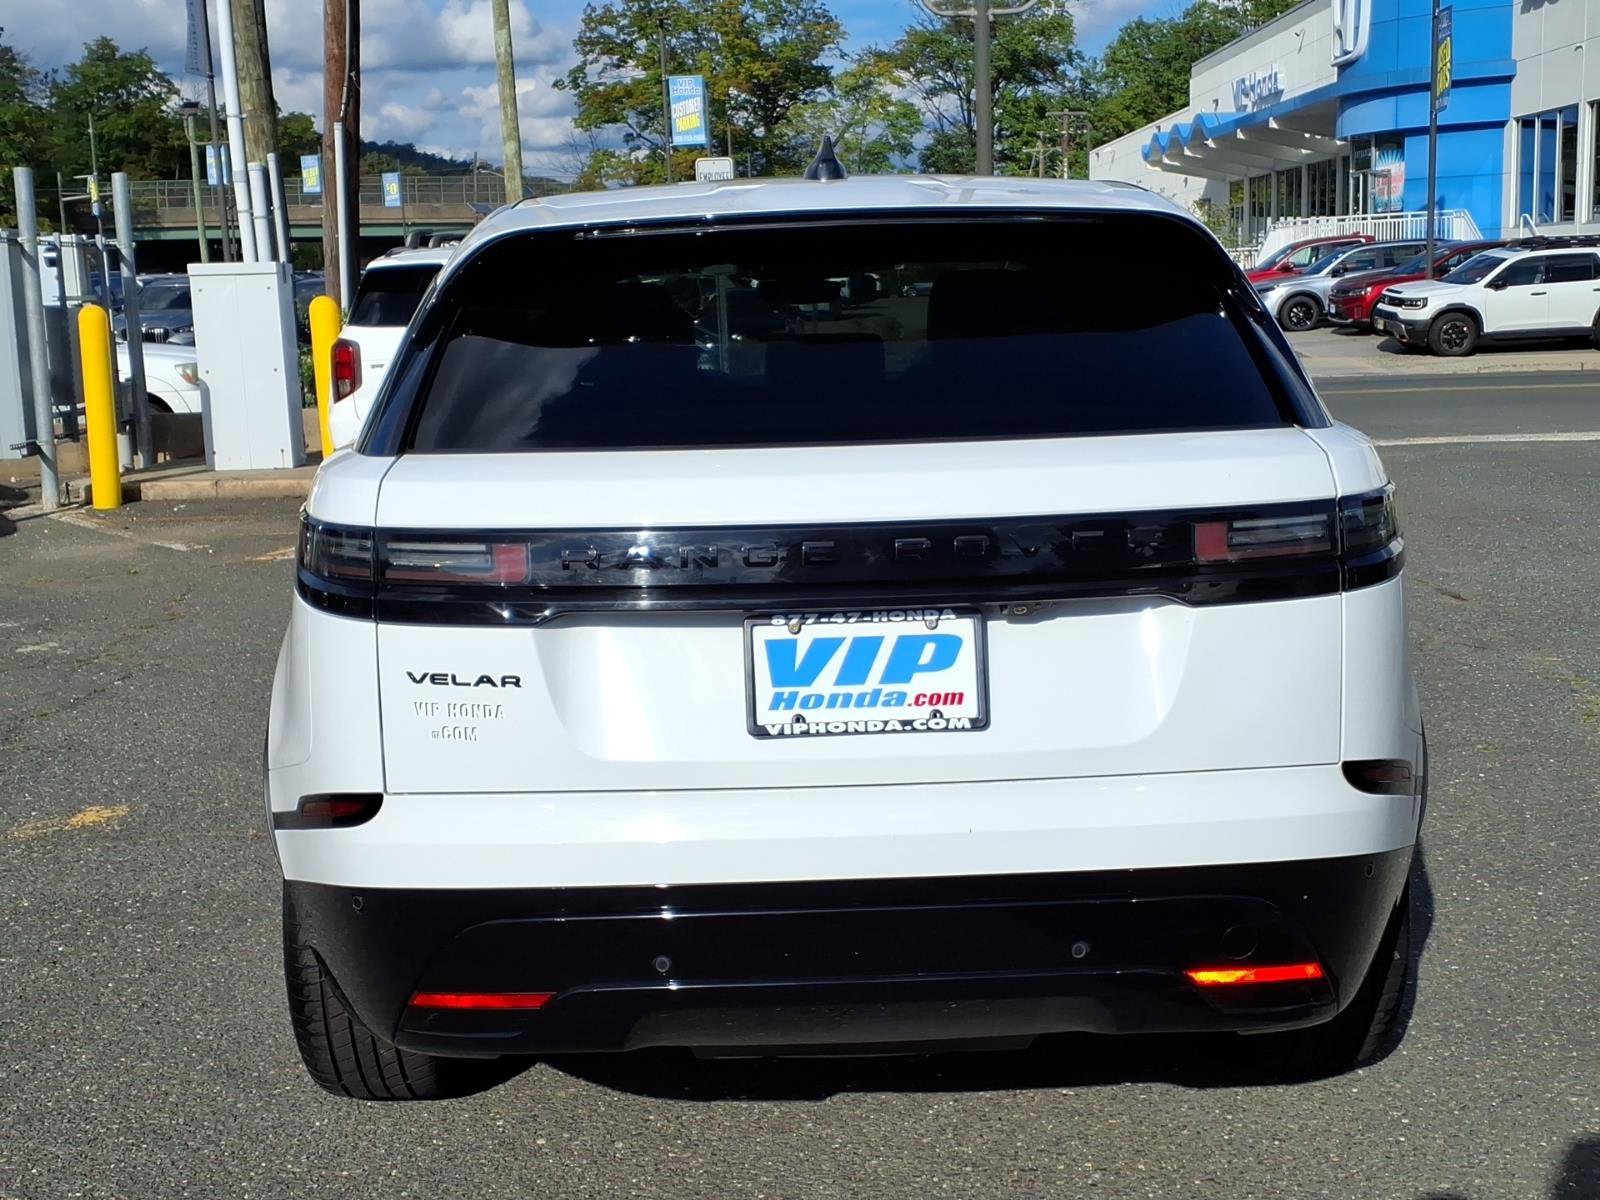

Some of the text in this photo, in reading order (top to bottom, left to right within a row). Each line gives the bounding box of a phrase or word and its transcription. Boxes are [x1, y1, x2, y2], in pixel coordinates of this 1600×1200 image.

[672, 86, 701, 95] Honda
[678, 79, 694, 88] VIP
[561, 540, 836, 571] RANGE
[764, 633, 964, 688] VIP
[406, 671, 522, 688] VELAR
[413, 701, 505, 719] VIP HONDA
[764, 717, 972, 736] VIPHONDA.COM
